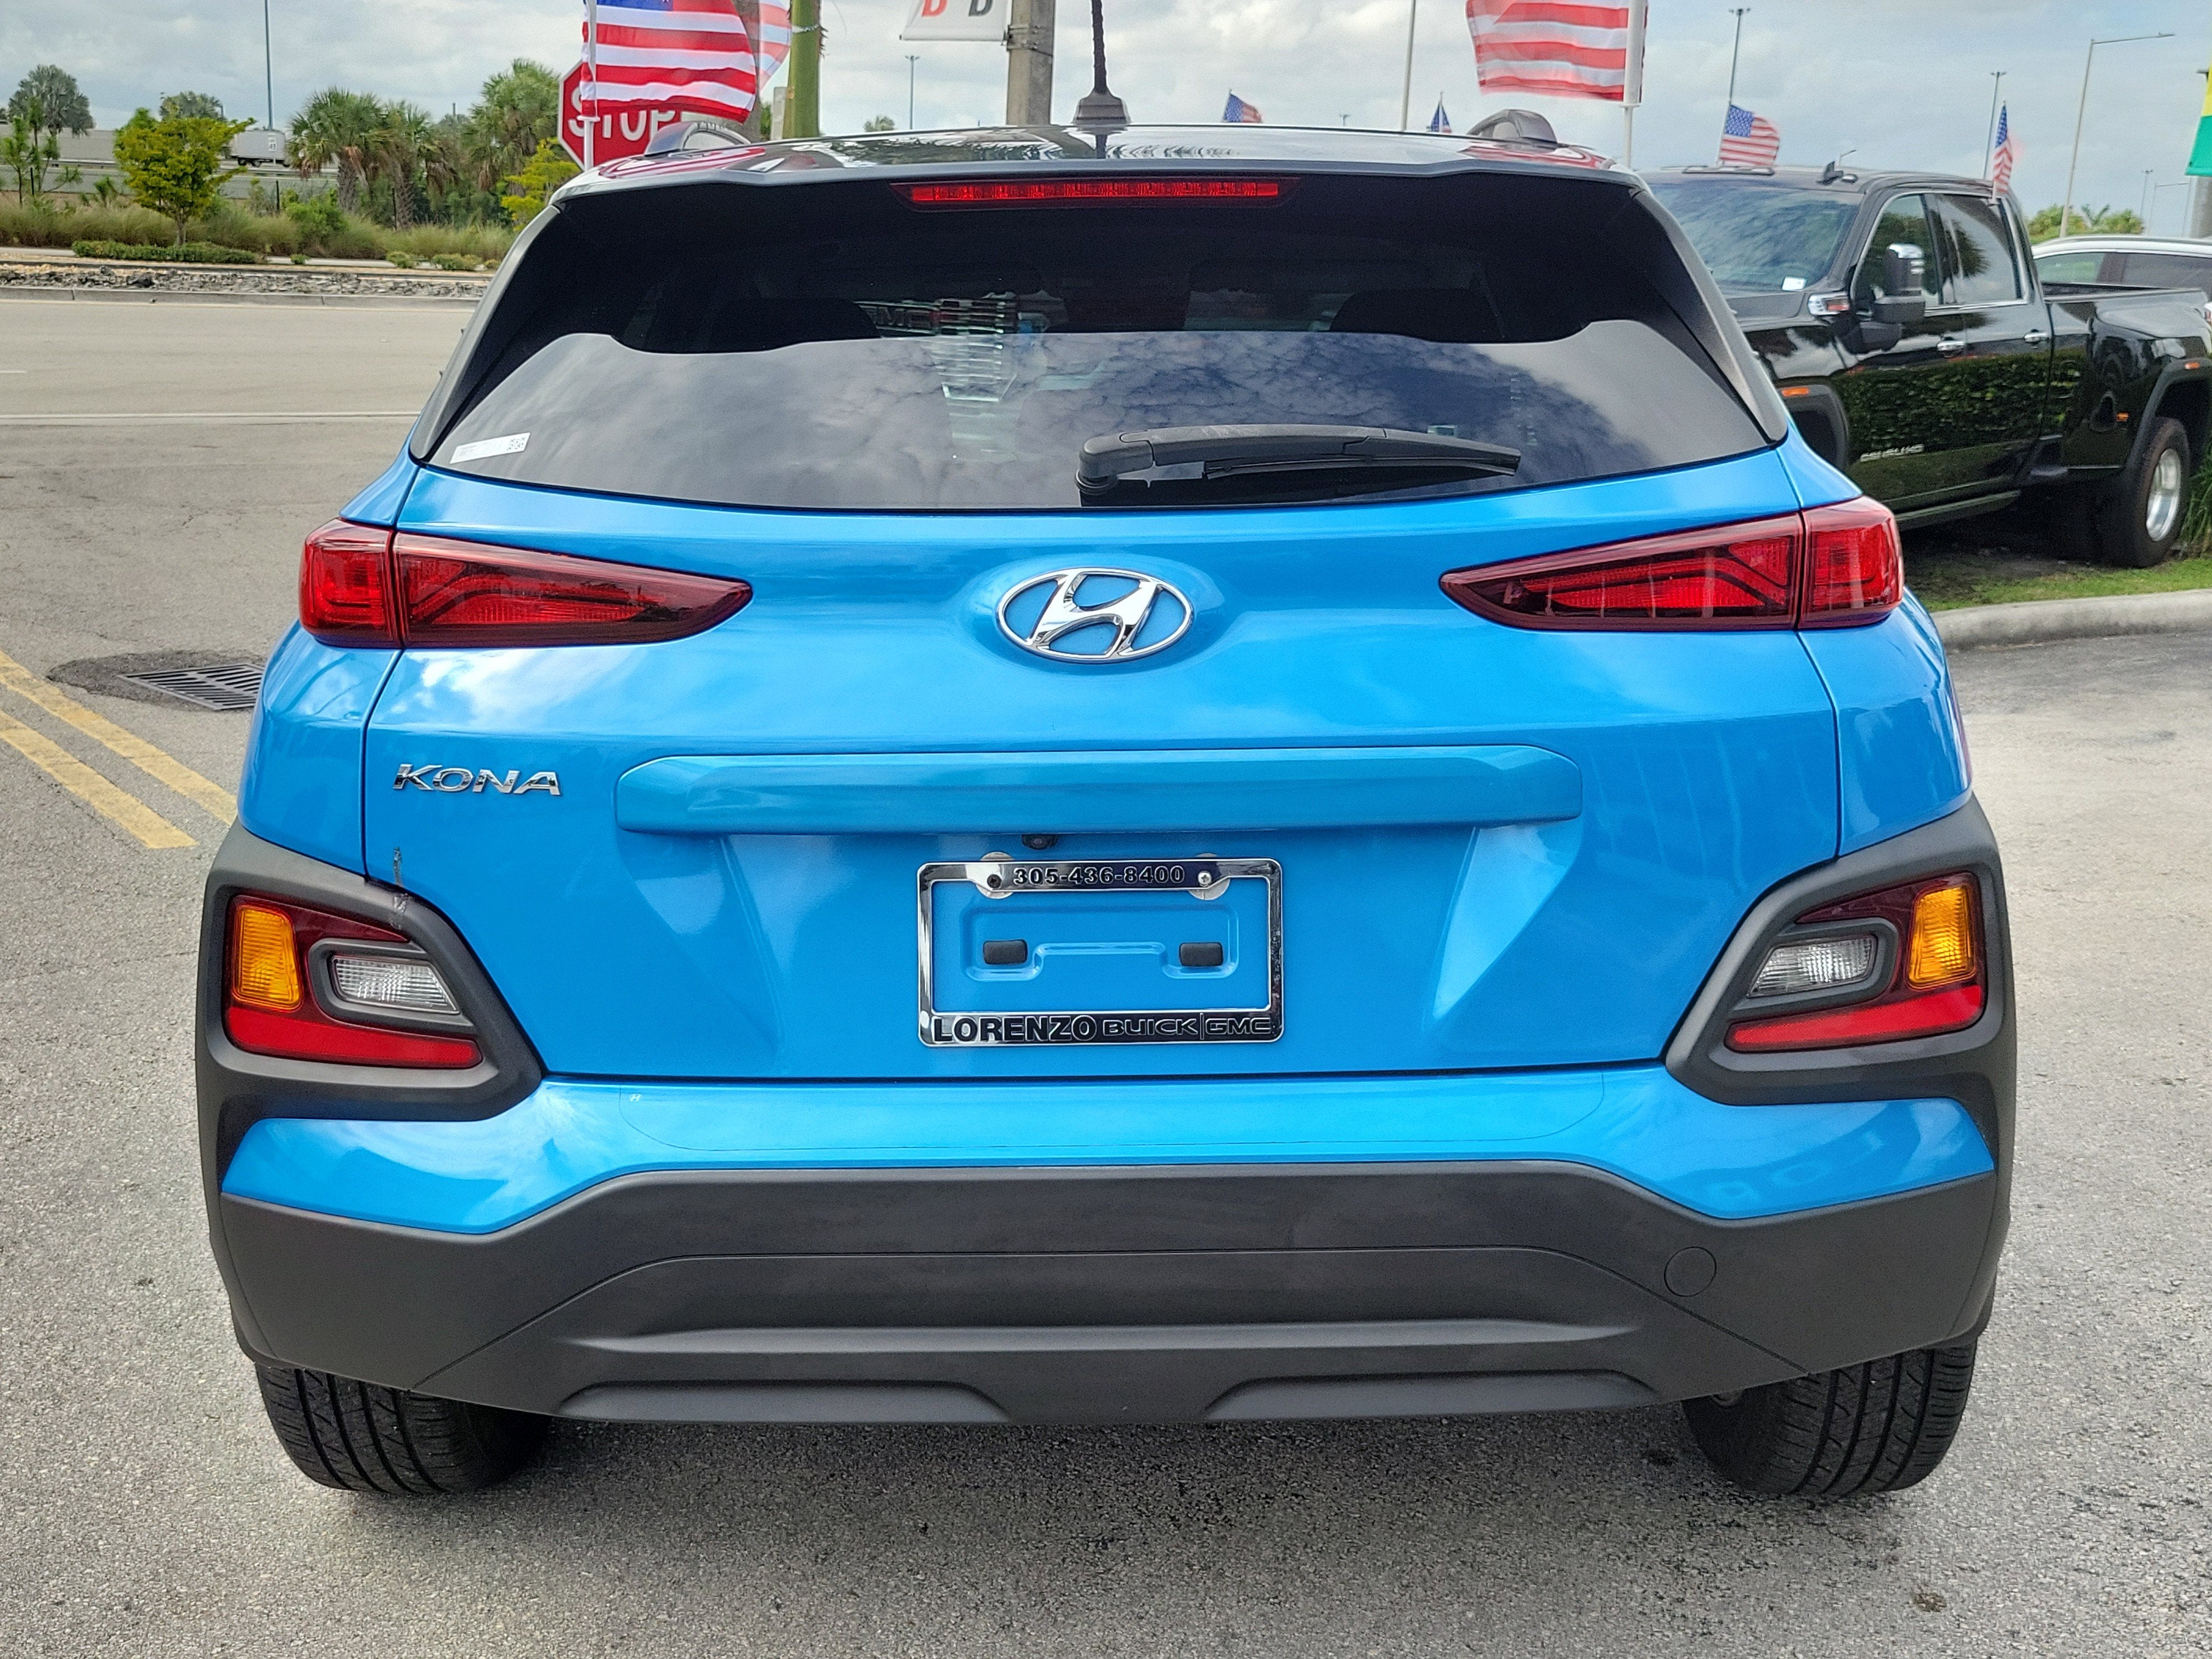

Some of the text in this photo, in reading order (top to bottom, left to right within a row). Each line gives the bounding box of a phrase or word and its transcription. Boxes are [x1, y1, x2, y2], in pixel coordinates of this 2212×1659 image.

[392, 764, 561, 795] KONA
[1013, 866, 1184, 884] 305-436-8400
[932, 1015, 1271, 1042] LORENZO BUICK GMC
